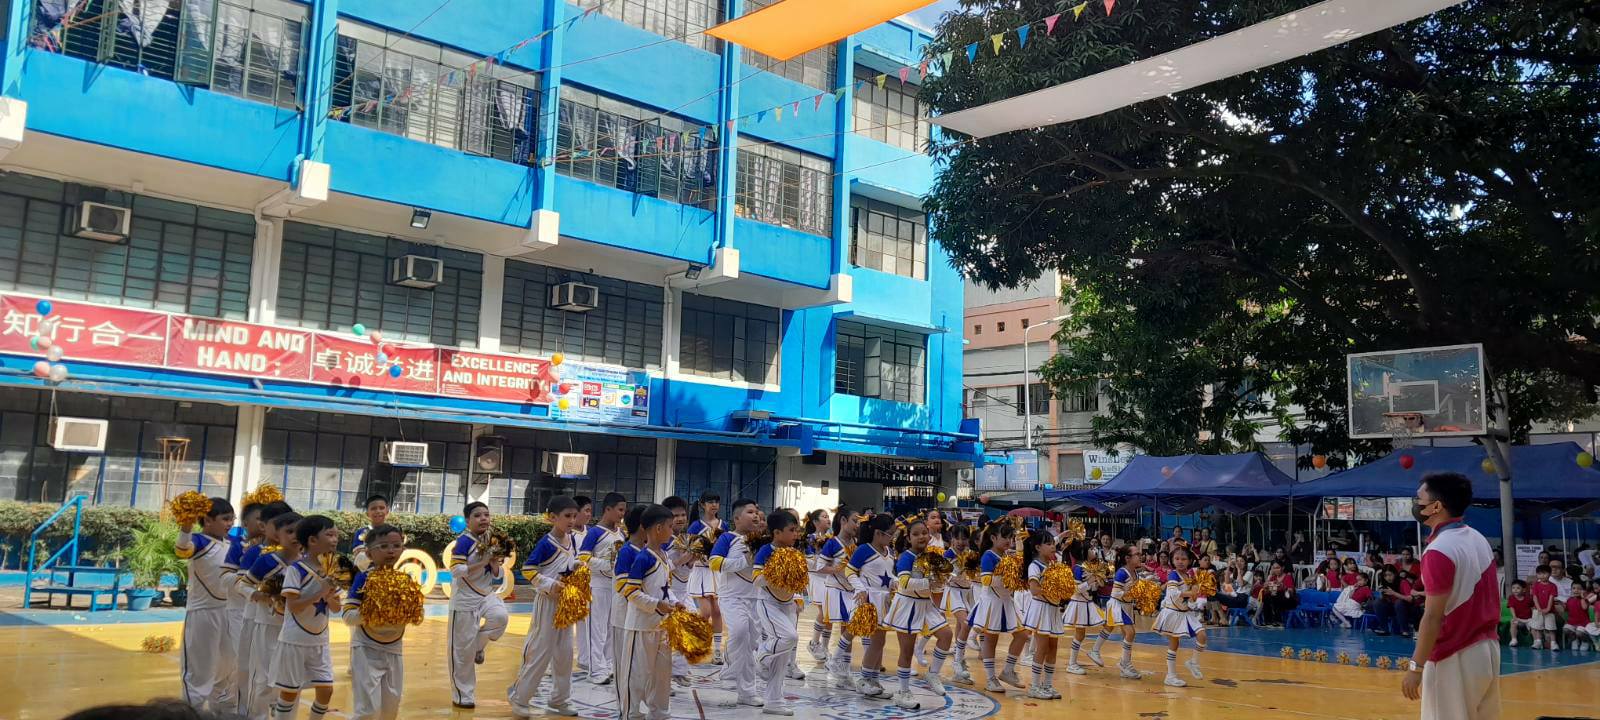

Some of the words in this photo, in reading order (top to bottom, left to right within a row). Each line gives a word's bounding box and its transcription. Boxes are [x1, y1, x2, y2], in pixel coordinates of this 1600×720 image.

[3, 308, 164, 347] 知行合一
[183, 318, 248, 345] MIND
[257, 330, 305, 353] AND
[443, 370, 473, 384] AND
[451, 353, 540, 375] EXCELLENCE
